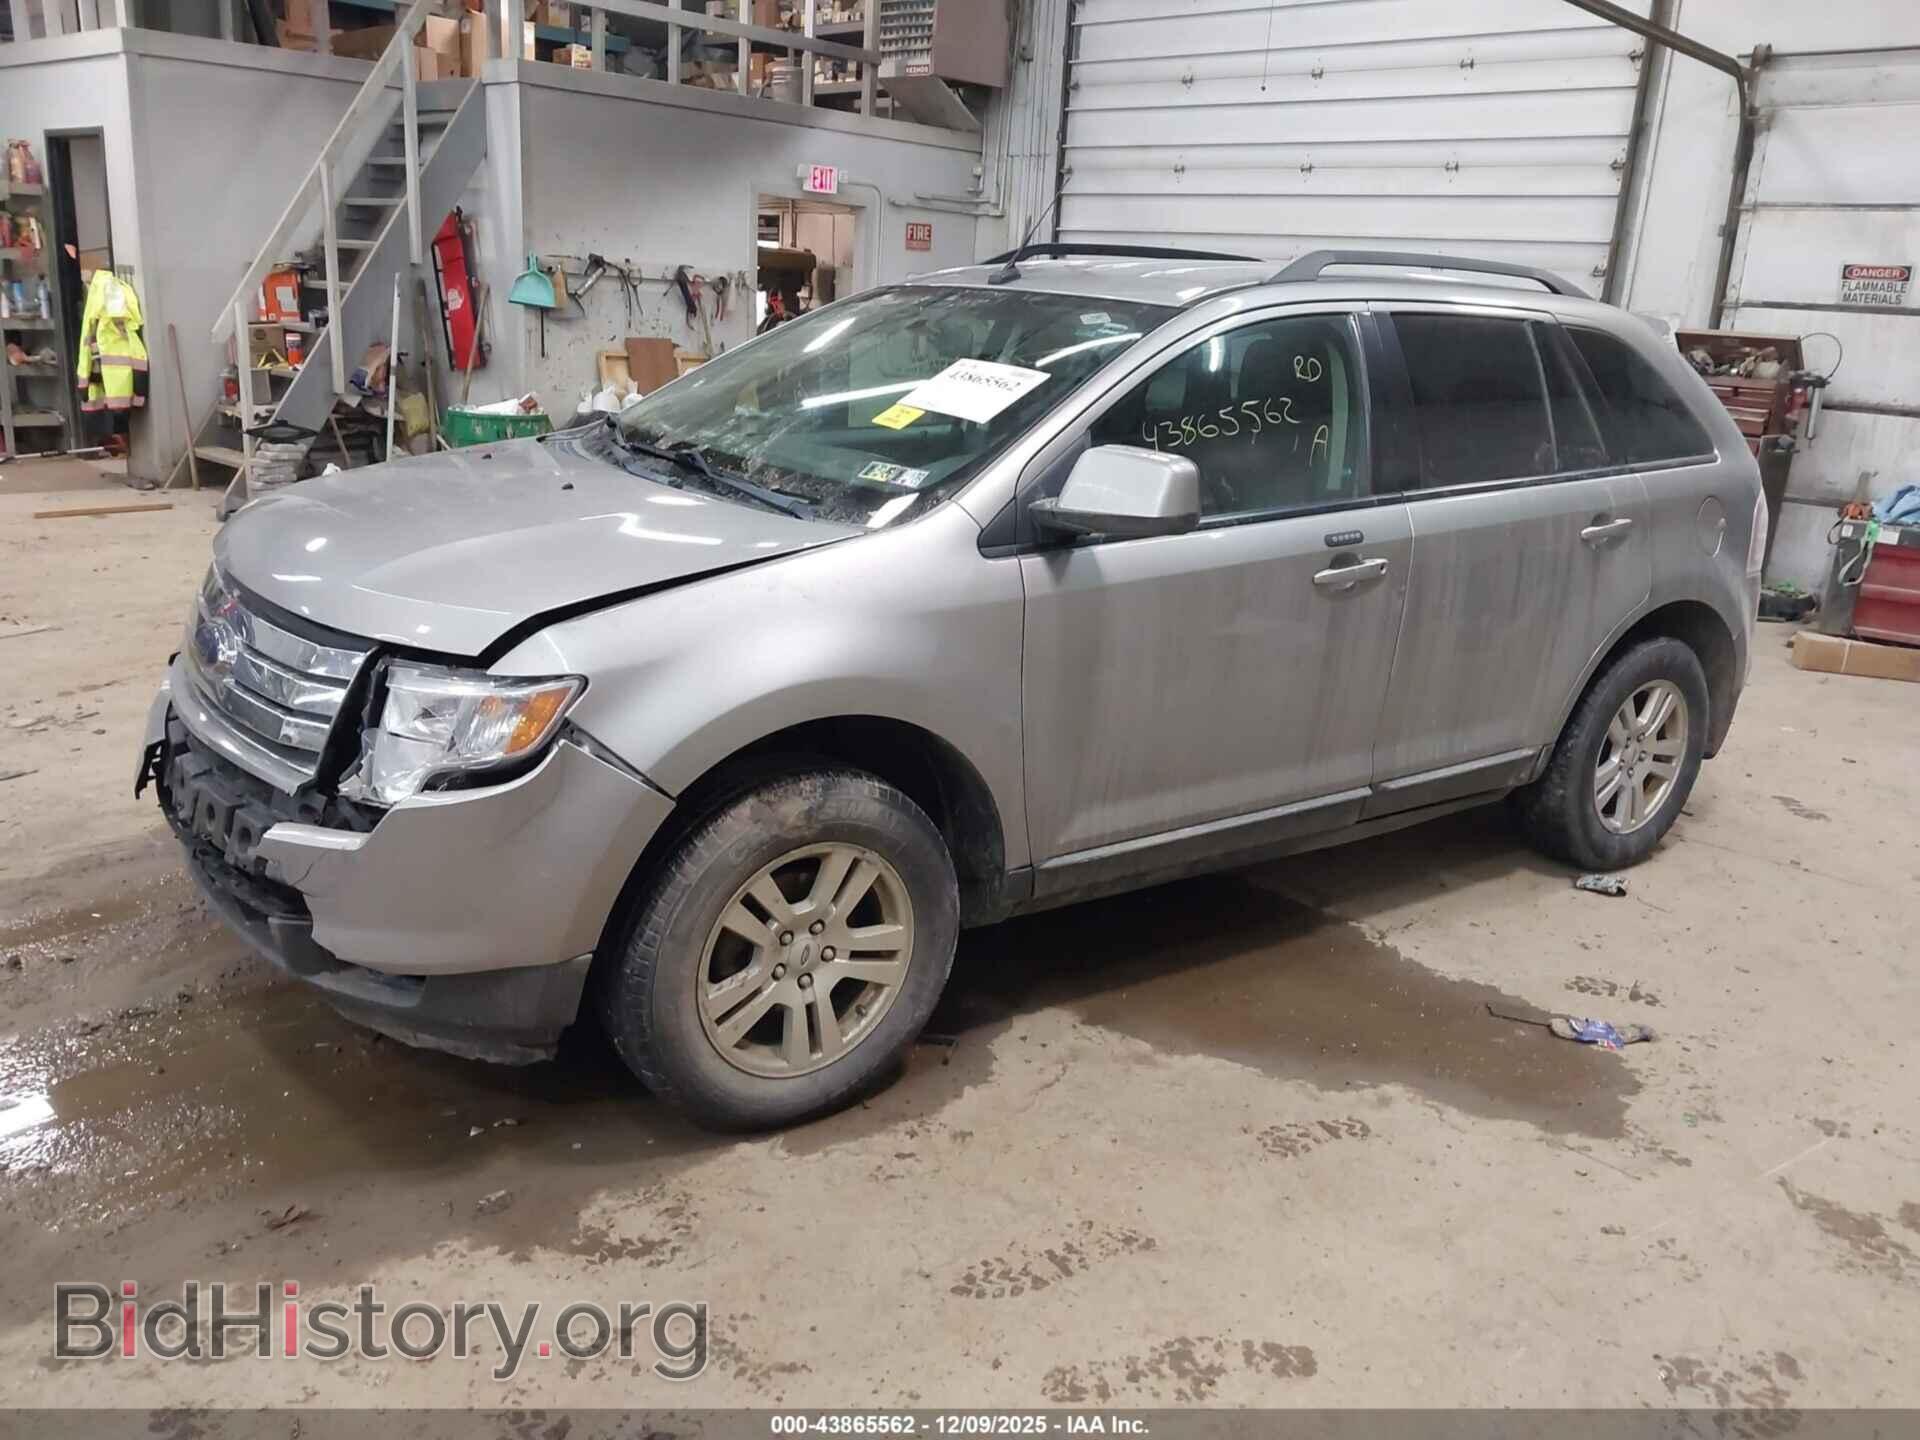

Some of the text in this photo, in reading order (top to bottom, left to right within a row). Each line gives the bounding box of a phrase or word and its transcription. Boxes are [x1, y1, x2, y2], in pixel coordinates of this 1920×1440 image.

[812, 167, 834, 191] EXIT
[907, 223, 931, 241] FIRE
[1852, 267, 1901, 278] DANGER
[1841, 280, 1907, 294] FLAMMABLE
[1842, 292, 1903, 305] MATERIALS
[1142, 397, 1301, 454] 43865562
